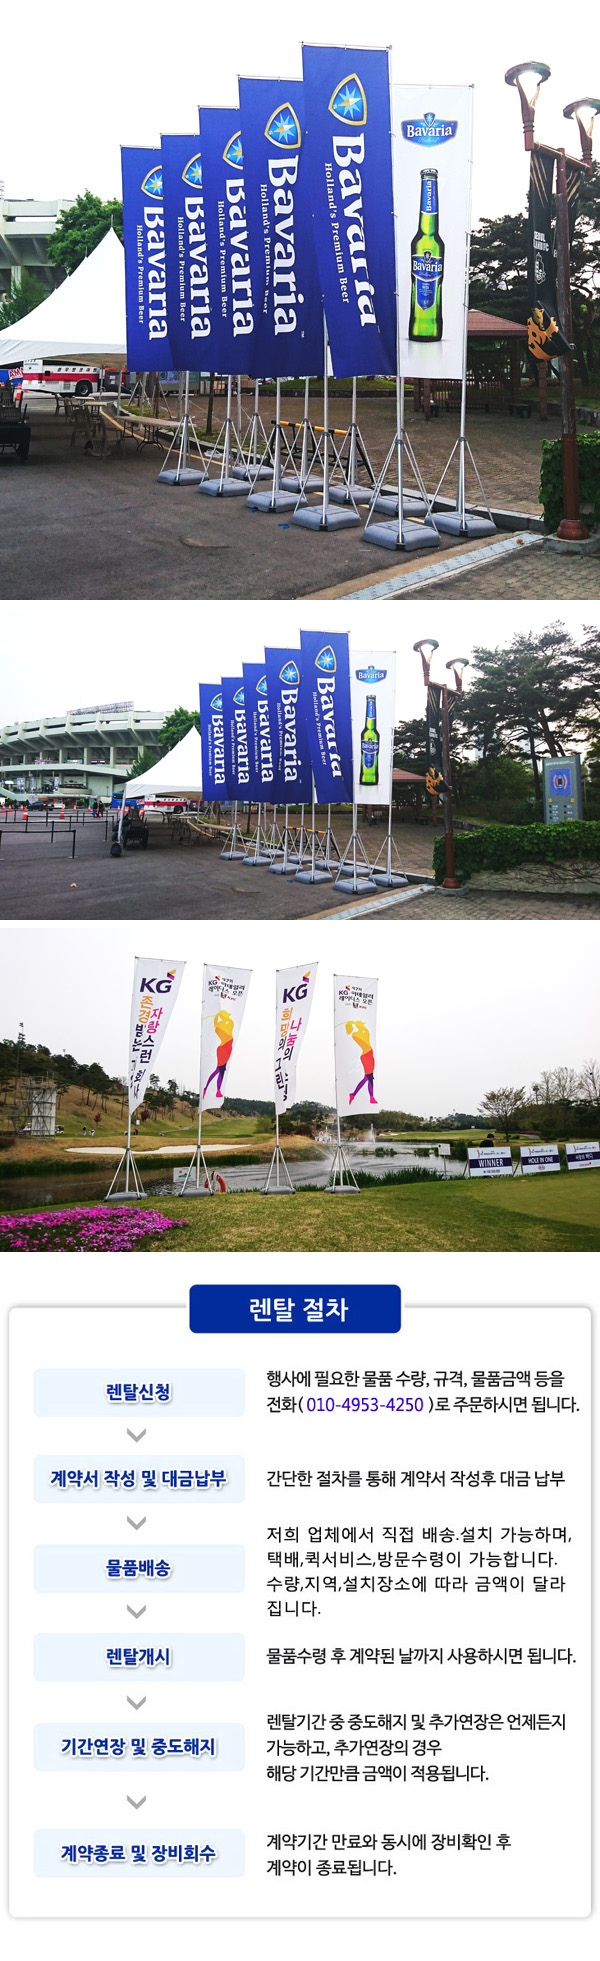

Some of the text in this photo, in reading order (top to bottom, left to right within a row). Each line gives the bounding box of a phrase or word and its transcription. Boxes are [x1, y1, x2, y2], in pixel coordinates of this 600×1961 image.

[407, 125, 452, 137] Bavaria
[261, 184, 270, 235] Holland's
[325, 163, 349, 303] Holland's Premium Beer
[226, 178, 254, 337] Bavaria
[267, 155, 305, 335] Bavaria
[413, 260, 442, 271] Bavaria
[281, 688, 301, 782] Bavaria
[140, 978, 172, 993] KG
[283, 984, 308, 1003] KG
[140, 1007, 163, 1063] 자랑스런
[275, 1007, 294, 1089] 희망의 그린
[478, 1159, 503, 1167] WINNER
